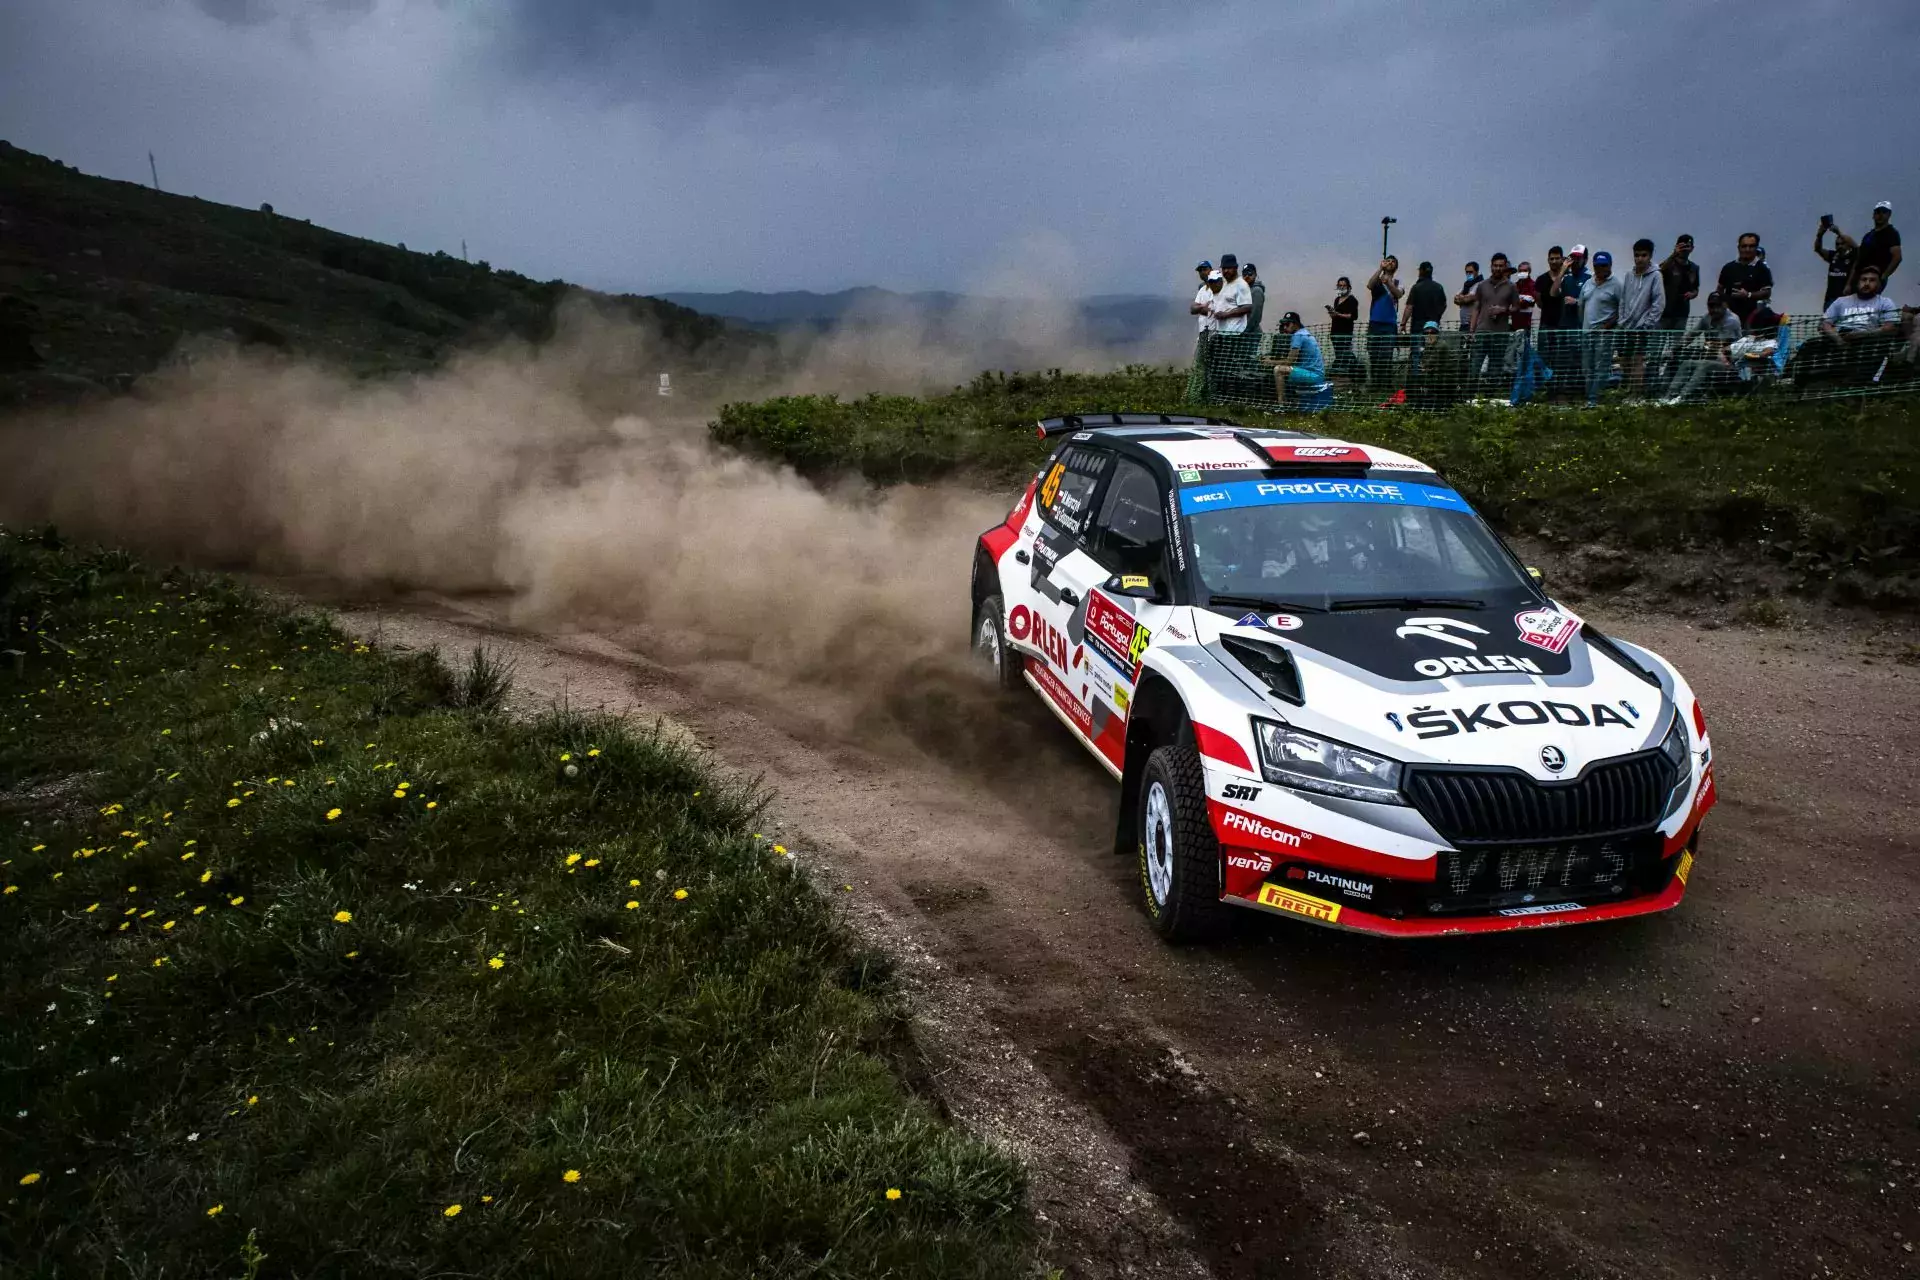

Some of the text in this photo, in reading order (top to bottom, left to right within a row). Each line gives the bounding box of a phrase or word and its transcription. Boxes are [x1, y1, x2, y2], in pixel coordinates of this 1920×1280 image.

[1041, 463, 1066, 508] 45
[1192, 492, 1225, 503] WRC2
[1100, 615, 1129, 648] Portugal
[1278, 616, 1291, 626] E
[1009, 604, 1068, 676] ORLEN
[1129, 625, 1151, 664] 45
[1414, 655, 1543, 677] ORLEN
[1406, 700, 1636, 740] ŠKODA
[1222, 783, 1263, 801] SRT
[1223, 811, 1312, 848] PFNteam 100
[1227, 855, 1273, 872] verva
[1139, 843, 1160, 918] SCORPION
[1307, 870, 1374, 894] PLATINUM
[1266, 887, 1333, 920] PIRELLI
